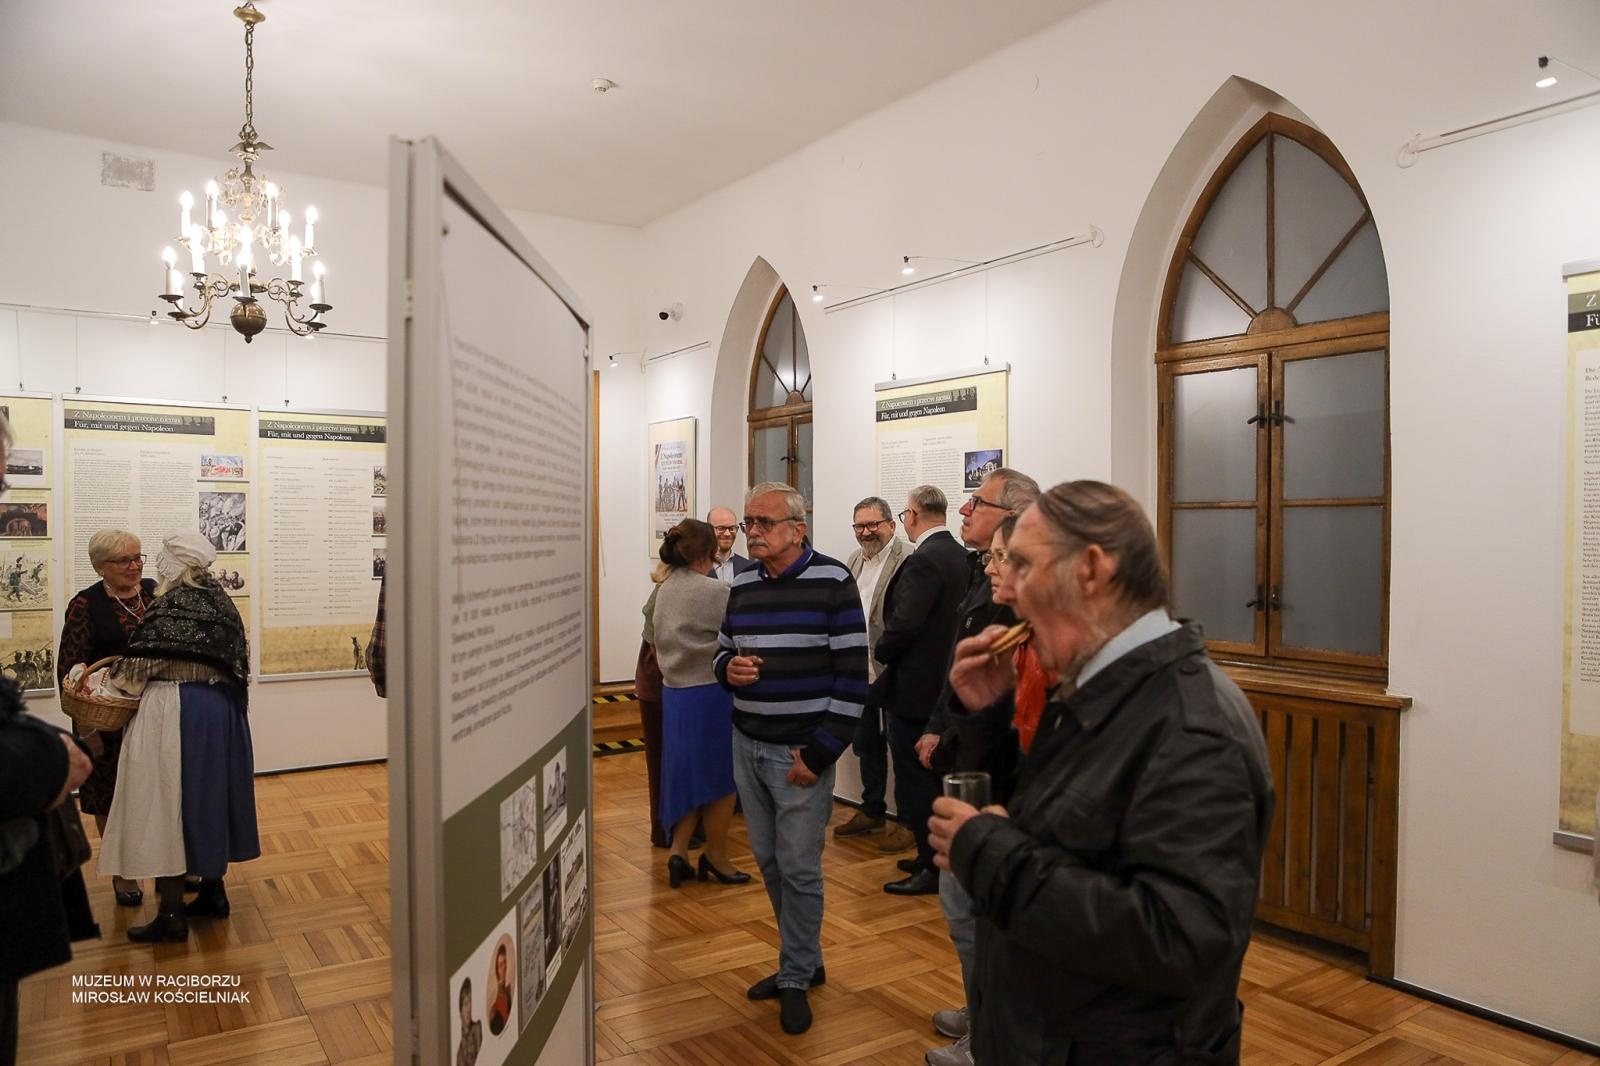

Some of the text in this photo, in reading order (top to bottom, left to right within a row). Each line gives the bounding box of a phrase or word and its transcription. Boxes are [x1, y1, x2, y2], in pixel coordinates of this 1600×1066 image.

[1586, 294, 1597, 307] Z
[82, 411, 126, 421] Napoleonem
[891, 411, 899, 419] mit
[899, 409, 909, 419] und
[909, 409, 922, 418] gegen
[923, 406, 946, 416] Napoleon
[90, 421, 103, 429] mit
[104, 422, 119, 430] und
[120, 424, 140, 432] gegen
[142, 423, 174, 433] Napoleon
[274, 421, 312, 431] Napoleonem
[267, 430, 280, 439] Für,
[305, 433, 324, 441] gegen
[325, 433, 352, 441] Napoleon
